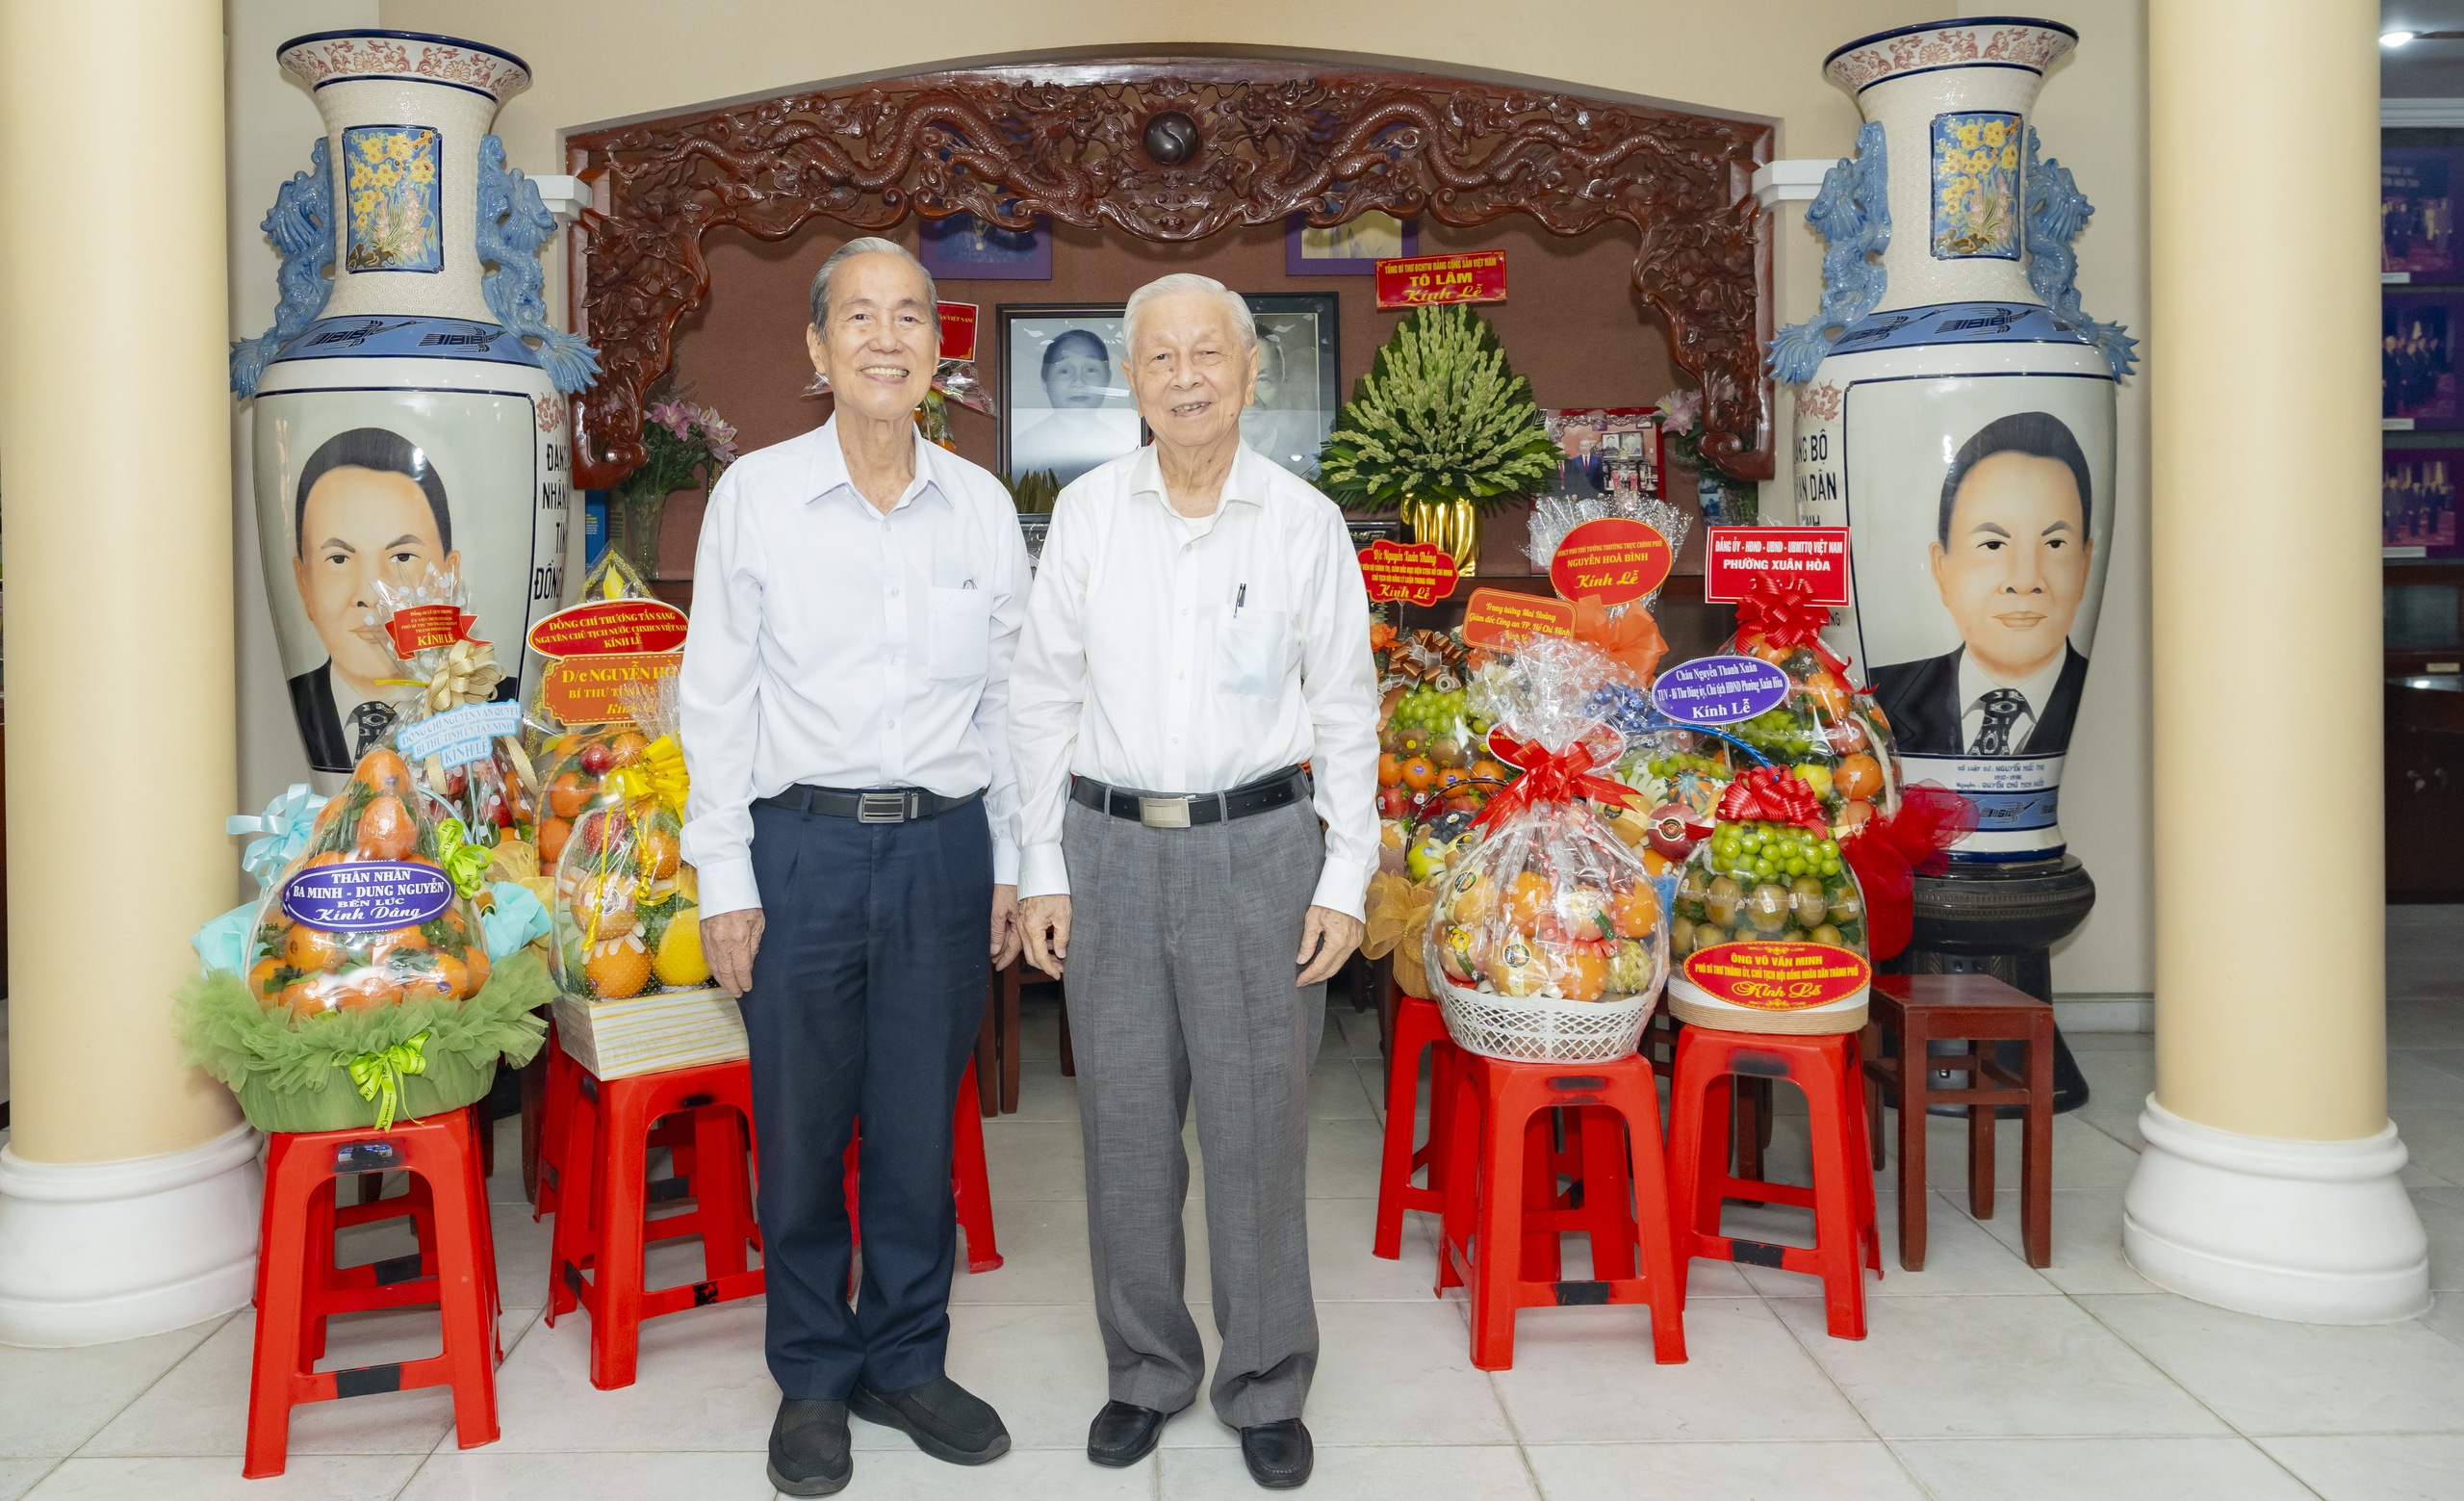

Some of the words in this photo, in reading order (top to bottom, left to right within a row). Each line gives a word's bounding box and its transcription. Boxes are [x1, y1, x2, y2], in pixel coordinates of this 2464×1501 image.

[1385, 264, 1398, 274] TỔNG
[1398, 264, 1403, 273] BÍ
[1433, 260, 1447, 271] ĐẢNG
[1448, 259, 1461, 272] CỘNG
[1462, 257, 1473, 269] SẢN
[1474, 256, 1483, 269] VIỆT
[1484, 258, 1497, 267] NAM
[1409, 273, 1430, 287] TÔ
[1436, 272, 1473, 285] LÂM
[1400, 287, 1451, 302] Kính
[1456, 283, 1483, 298] Lễ
[1811, 428, 1828, 465] BỘ
[1810, 469, 1837, 502] DÂN
[1603, 542, 1623, 551] THƯỜNG
[1732, 536, 1741, 552] ỦY
[1767, 541, 1783, 553] UBND
[1788, 541, 1812, 555] UBMTTQ
[1813, 538, 1828, 556] VIỆT
[1829, 542, 1843, 554] NAM
[1420, 551, 1437, 566] Thắng
[1567, 554, 1601, 568] NGUYỄN
[1603, 554, 1622, 564] HOÀ
[1625, 552, 1648, 562] BÌNH
[1724, 557, 1768, 570] PHƯỜNG
[1772, 557, 1803, 570] XUÂN
[1806, 559, 1831, 571] HÒA
[1575, 573, 1613, 588] Kính
[1616, 570, 1639, 585] Lễ
[1413, 587, 1430, 600] Lễ
[579, 616, 598, 627] CHÍ
[599, 612, 638, 624] TRƯƠNG
[638, 609, 656, 620] TẤN
[1486, 603, 1503, 614] Trung
[1523, 608, 1534, 617] Mai
[1535, 610, 1556, 623] Hoàng
[1469, 612, 1484, 622] Giám
[1485, 615, 1496, 624] đốc
[1496, 618, 1510, 629] Công
[1521, 621, 1531, 630] TP.
[1554, 627, 1570, 635] Minh
[418, 633, 444, 646] KÍNH
[535, 634, 568, 644] NGUYÊN
[569, 632, 586, 640] CHỦ
[586, 630, 607, 638] TỊCH
[608, 625, 630, 635] NƯỚC
[661, 623, 675, 632] VIỆT
[604, 636, 629, 648] KÍNH
[630, 633, 642, 645] LỄ
[590, 661, 651, 682] NGUYỄN
[1676, 669, 1693, 681] Cháu
[1694, 664, 1717, 681] Nguyễn
[1717, 663, 1739, 676] Thanh
[1739, 661, 1758, 673] Xuân
[1759, 678, 1772, 689] Xuân
[569, 687, 580, 698] BÍ
[583, 687, 609, 698] THƯ
[1692, 705, 1728, 718] Kính
[1732, 698, 1751, 714] Lễ
[492, 721, 513, 732] NINH
[445, 743, 475, 763] KÍNH
[475, 736, 488, 753] LỄ
[332, 870, 371, 884] THÂN
[373, 869, 411, 882] NHÂN
[294, 885, 305, 897] BA
[307, 887, 343, 898] MINH
[356, 885, 394, 897] DUNG
[398, 878, 445, 894] NGUYỄN
[313, 908, 365, 921] Kính
[370, 907, 422, 919] Dâng
[1731, 952, 1752, 965] ÔNG
[1755, 953, 1769, 965] VÕ
[1771, 954, 1793, 967] VĂN
[1795, 956, 1823, 966] MINH
[1724, 966, 1741, 976] THÀNH
[1763, 969, 1775, 981] TỊCH
[1801, 968, 1816, 979] NHÂN
[1817, 967, 1829, 978] DÂN
[1829, 966, 1847, 977] THÀNH
[1732, 980, 1785, 997] Kính
[1788, 982, 1822, 997] Lễ
